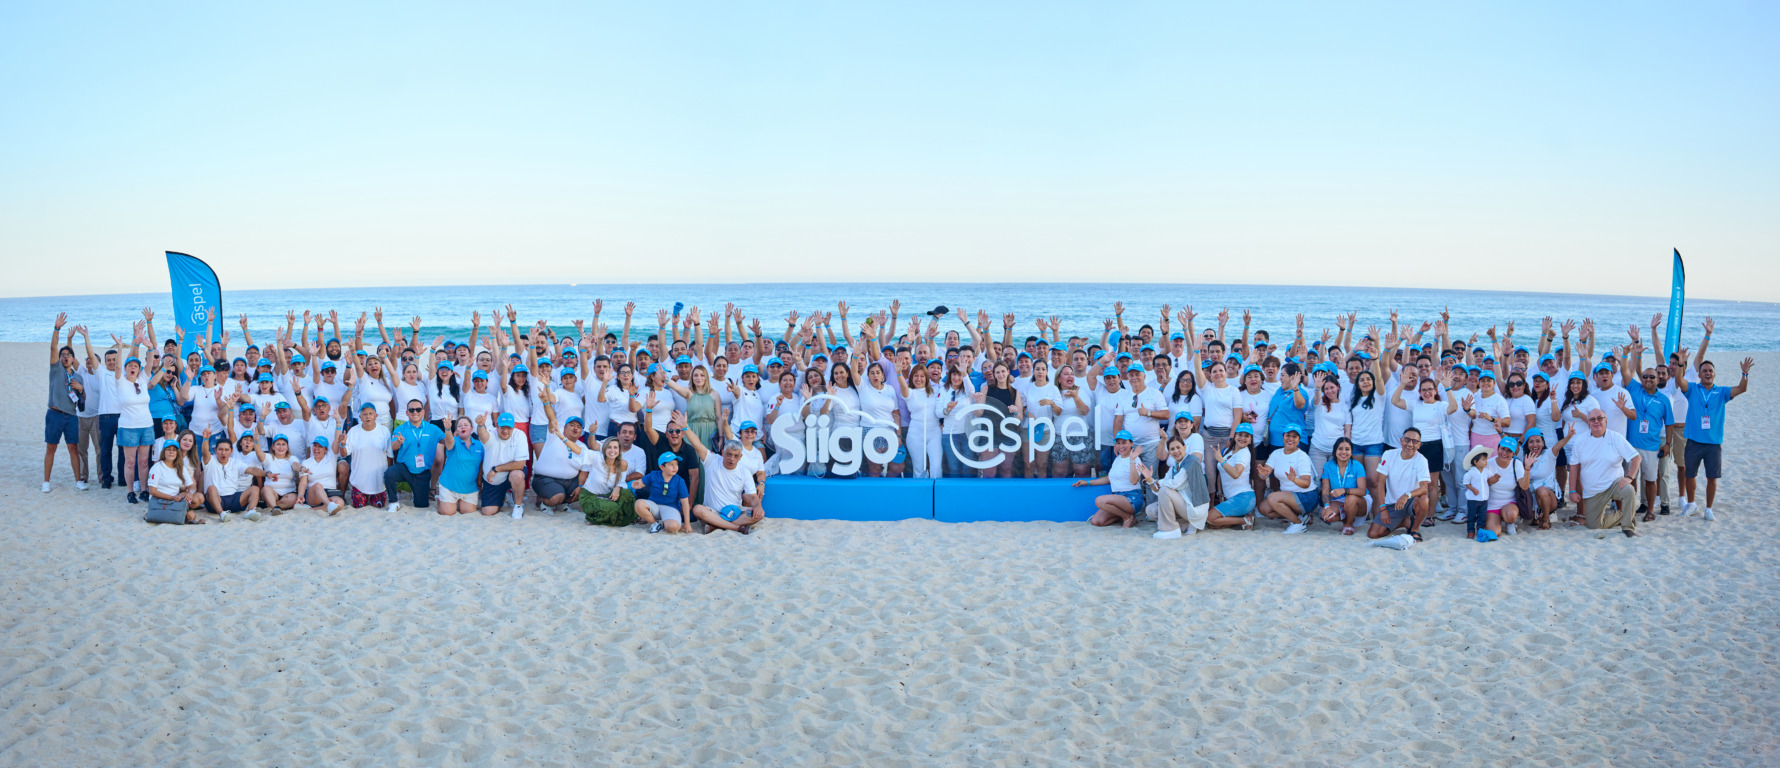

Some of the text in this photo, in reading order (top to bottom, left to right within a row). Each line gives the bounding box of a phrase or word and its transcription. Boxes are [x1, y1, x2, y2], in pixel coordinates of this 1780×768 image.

[189, 283, 207, 321] aspel
[771, 404, 1102, 476] Siigo aspel
